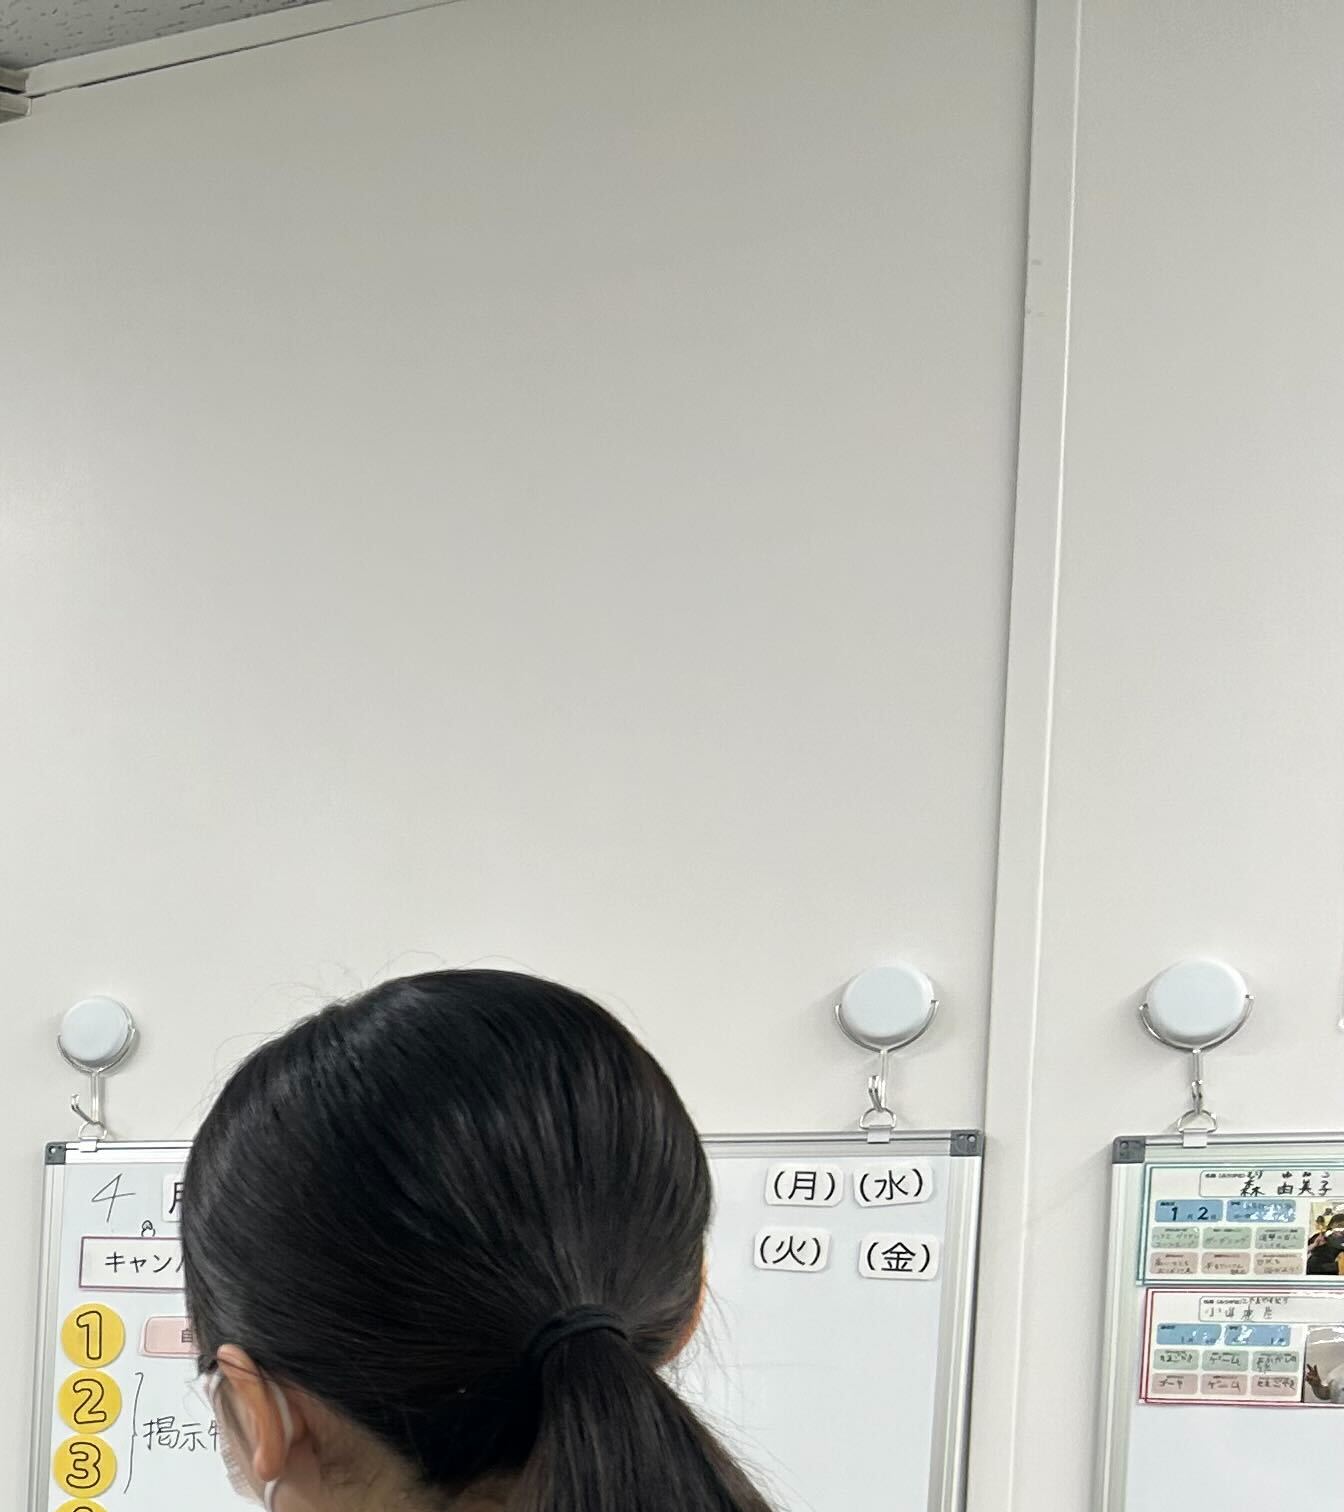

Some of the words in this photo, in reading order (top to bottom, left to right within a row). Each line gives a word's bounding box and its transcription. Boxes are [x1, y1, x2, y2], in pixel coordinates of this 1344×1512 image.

[91, 1173, 136, 1223] 4
[773, 1169, 836, 1202] （月）
[859, 1168, 924, 1202] （水）
[105, 1251, 184, 1273] キャン
[759, 1236, 822, 1267] （火）
[866, 1241, 932, 1275] （金）
[76, 1310, 104, 1360] 1
[72, 1378, 108, 1425] 2
[65, 1441, 102, 1489] 3
